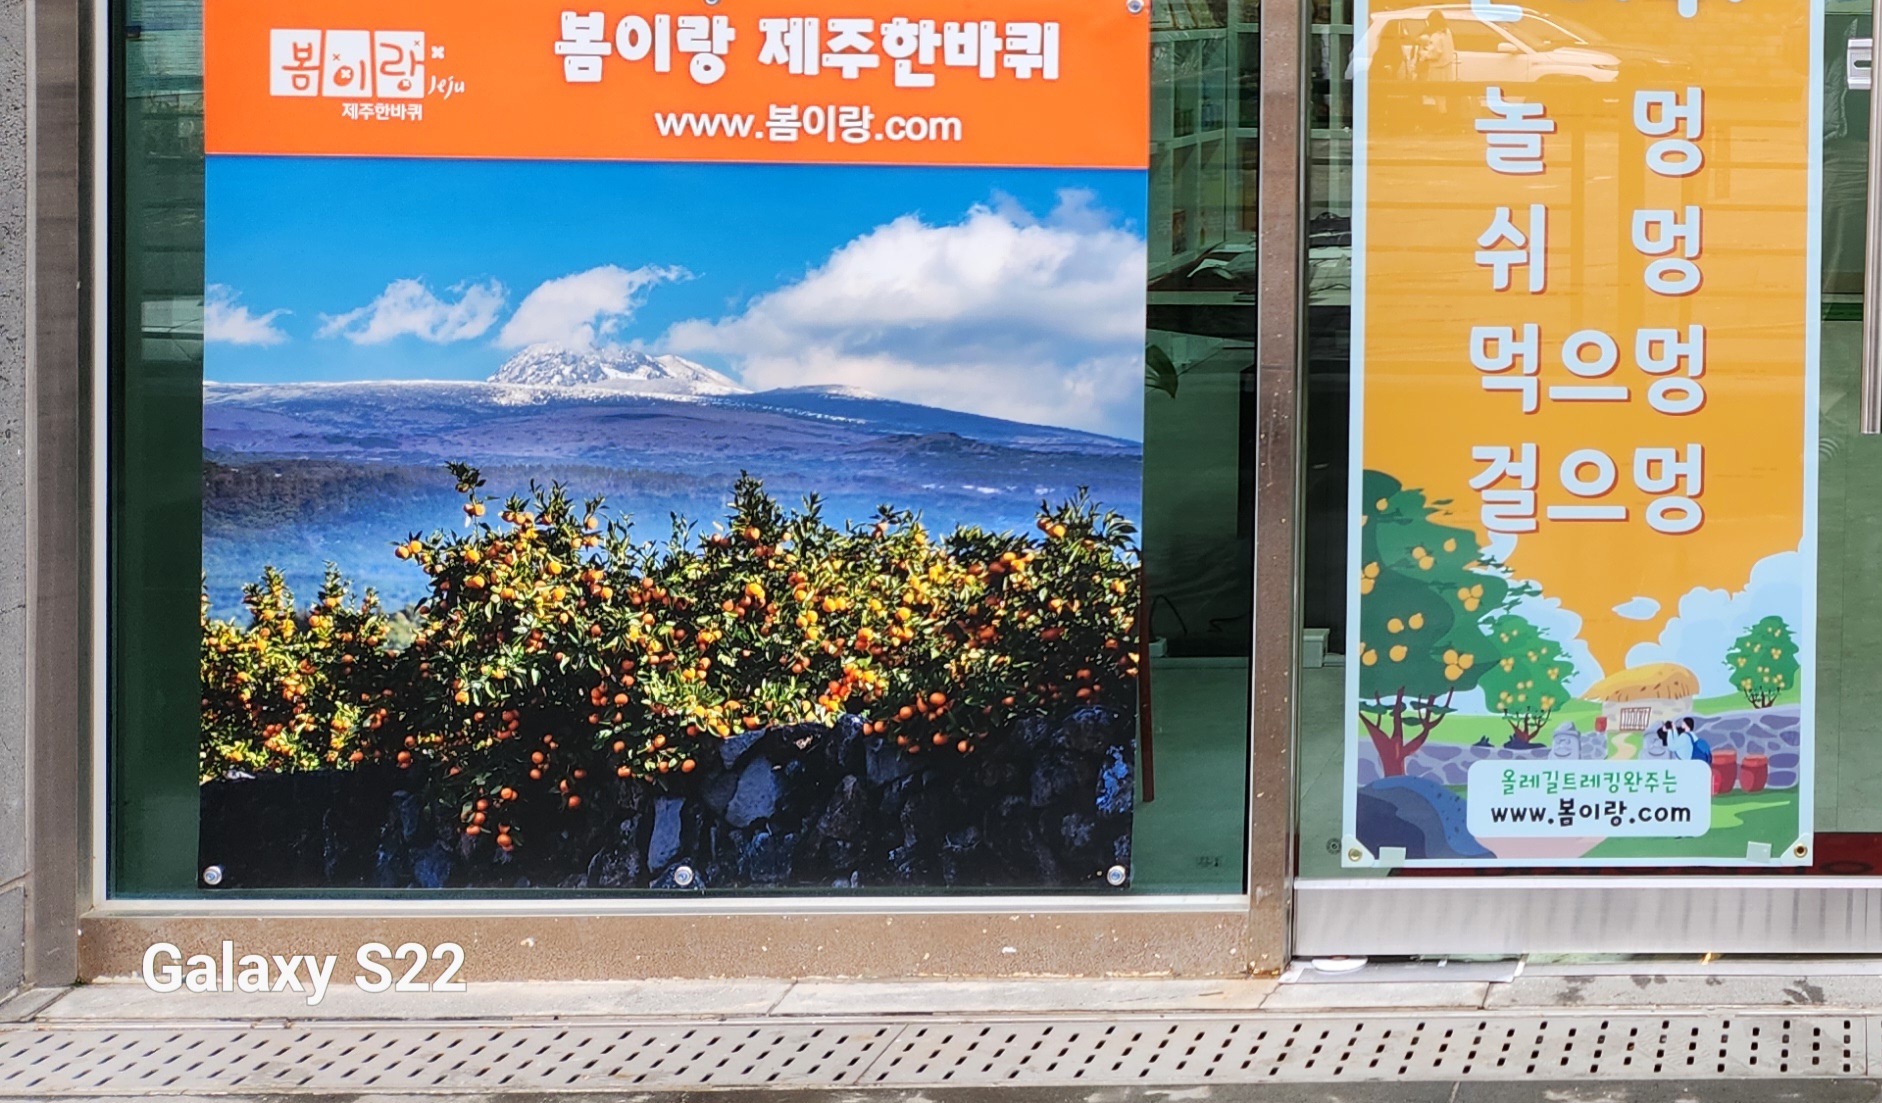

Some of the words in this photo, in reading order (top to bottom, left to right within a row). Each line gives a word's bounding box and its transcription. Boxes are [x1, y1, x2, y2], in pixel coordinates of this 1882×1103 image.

[427, 72, 466, 98] Jeju
[554, 10, 737, 84] 봄이랑
[757, 14, 1061, 86] 제주한바퀴
[341, 100, 424, 122] 제주한바퀴
[655, 104, 962, 143] www.봄이랑.com
[1474, 86, 1557, 175] 놀
[1633, 86, 1705, 177] 멍
[1474, 203, 1547, 294] 쉬
[1631, 205, 1703, 295] 멍
[1469, 323, 1707, 415] 먹으멍
[1468, 442, 1705, 535] 걸으멍
[1490, 797, 1692, 828] www.봄이랑.com
